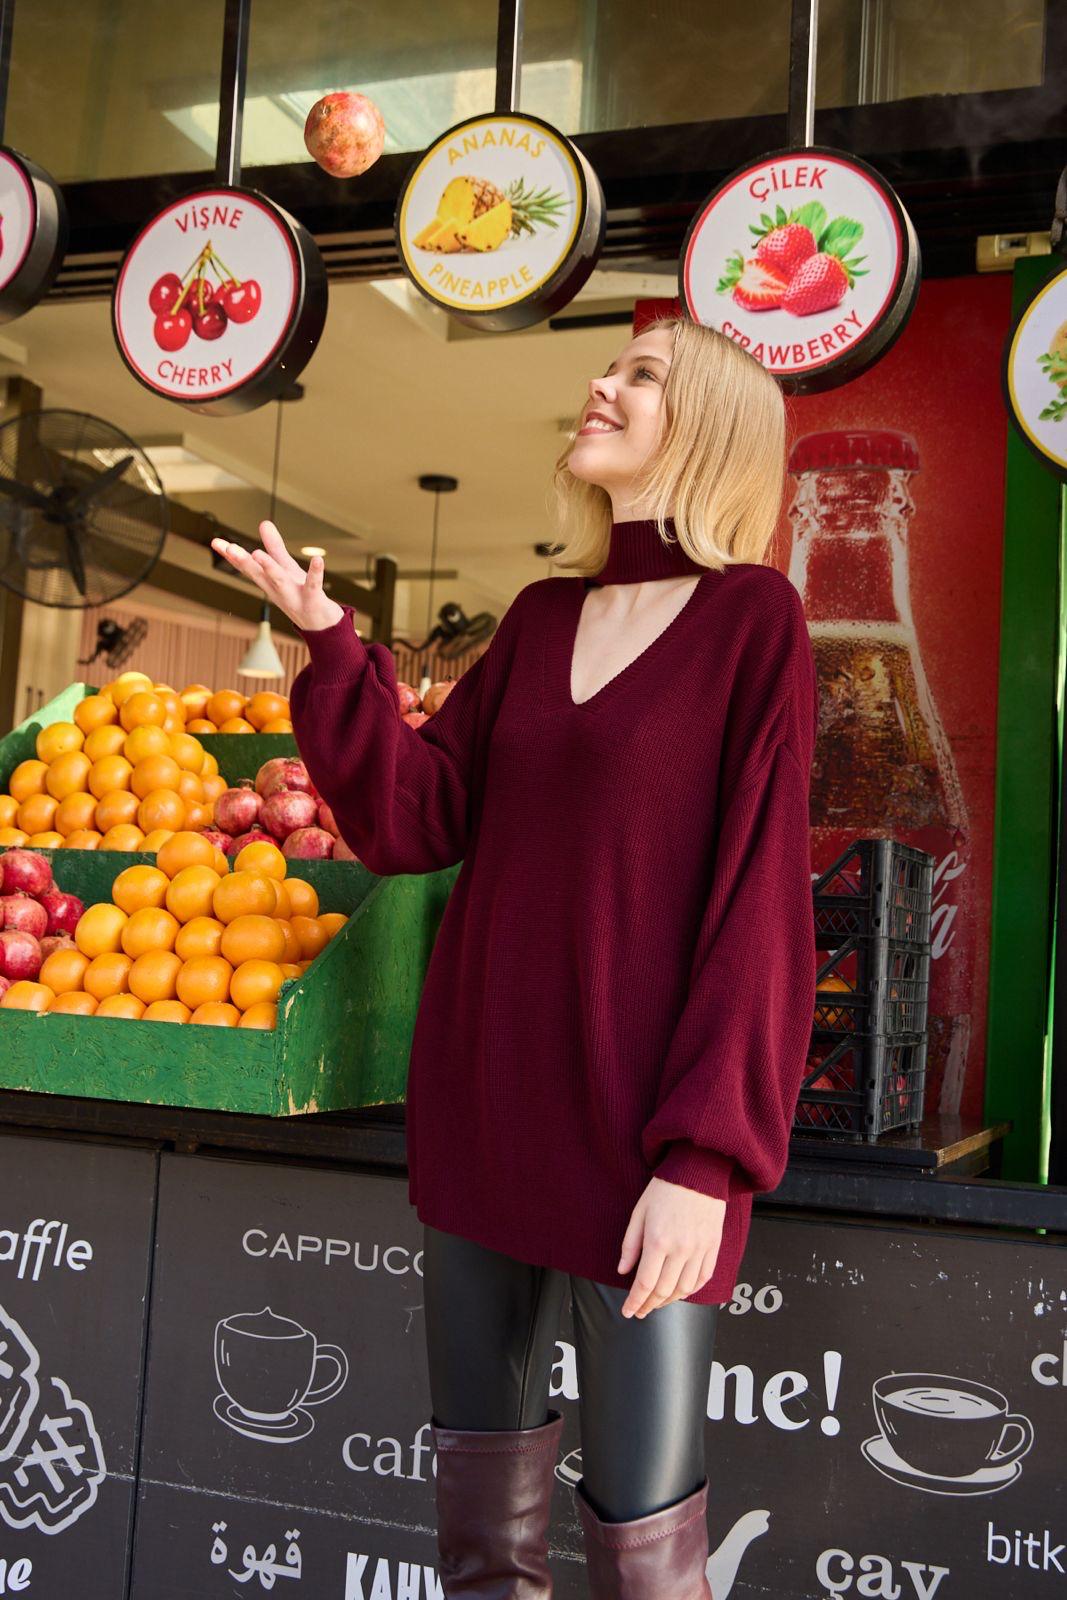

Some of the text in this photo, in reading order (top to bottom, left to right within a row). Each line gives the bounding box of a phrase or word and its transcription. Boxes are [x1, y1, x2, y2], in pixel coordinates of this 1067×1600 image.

[447, 127, 546, 166] ANANAS
[749, 166, 828, 202] ÇİLEK
[175, 206, 243, 234] VİŞNE
[428, 262, 534, 299] PINEAPPLE
[157, 358, 234, 386] CHERRY
[342, 1423, 438, 1482] caf
[210, 1520, 302, 1590] قهوة
